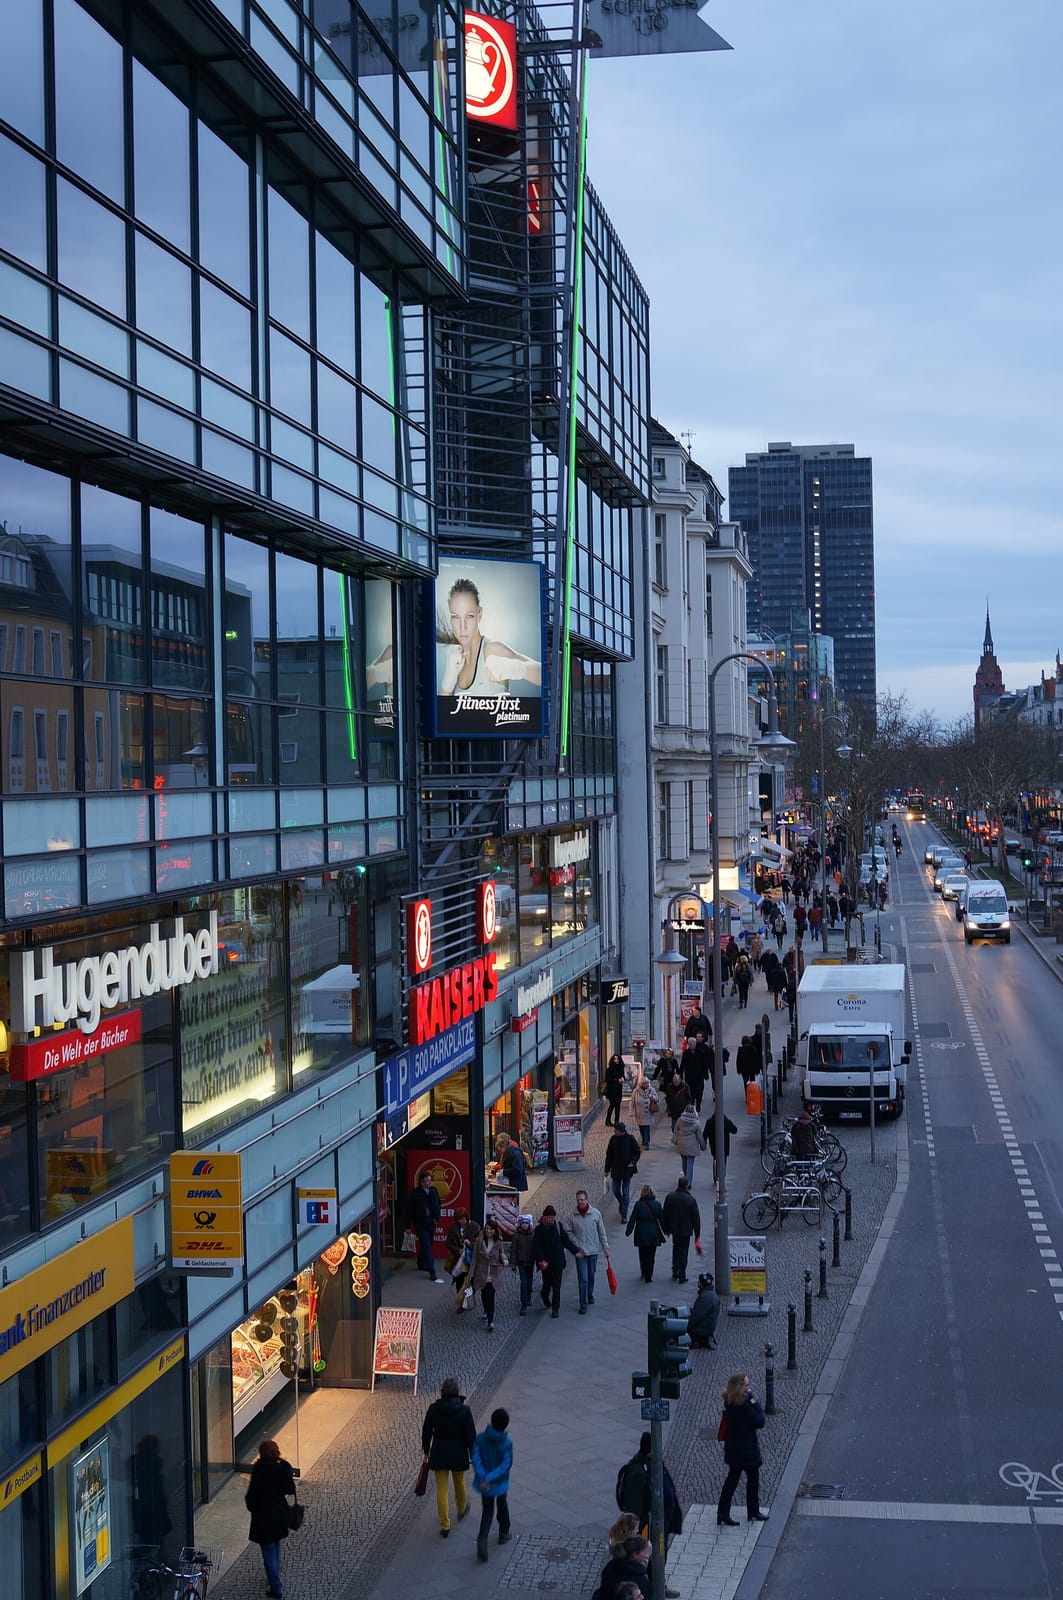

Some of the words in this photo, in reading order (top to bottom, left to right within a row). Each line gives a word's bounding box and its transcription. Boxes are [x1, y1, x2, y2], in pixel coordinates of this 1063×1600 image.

[495, 711, 530, 724] platinum
[22, 909, 219, 1034] Hugendubel
[416, 951, 499, 1046] KAISER'S
[837, 998, 867, 1006] Corona
[43, 1049, 60, 1070] Die
[61, 1039, 82, 1064] Welt
[83, 1037, 99, 1056] der
[100, 1027, 129, 1049] Bücher
[399, 1058, 408, 1101] P
[415, 1049, 428, 1079] 500
[429, 1019, 474, 1069] PARKPLÄTZE
[187, 1190, 214, 1198] BHW
[186, 1241, 225, 1251] DHL
[729, 1252, 766, 1267] Spikes
[28, 1267, 107, 1337] Finanzcenter
[165, 1345, 183, 1364] Postbank
[14, 1463, 39, 1488] Postbank
